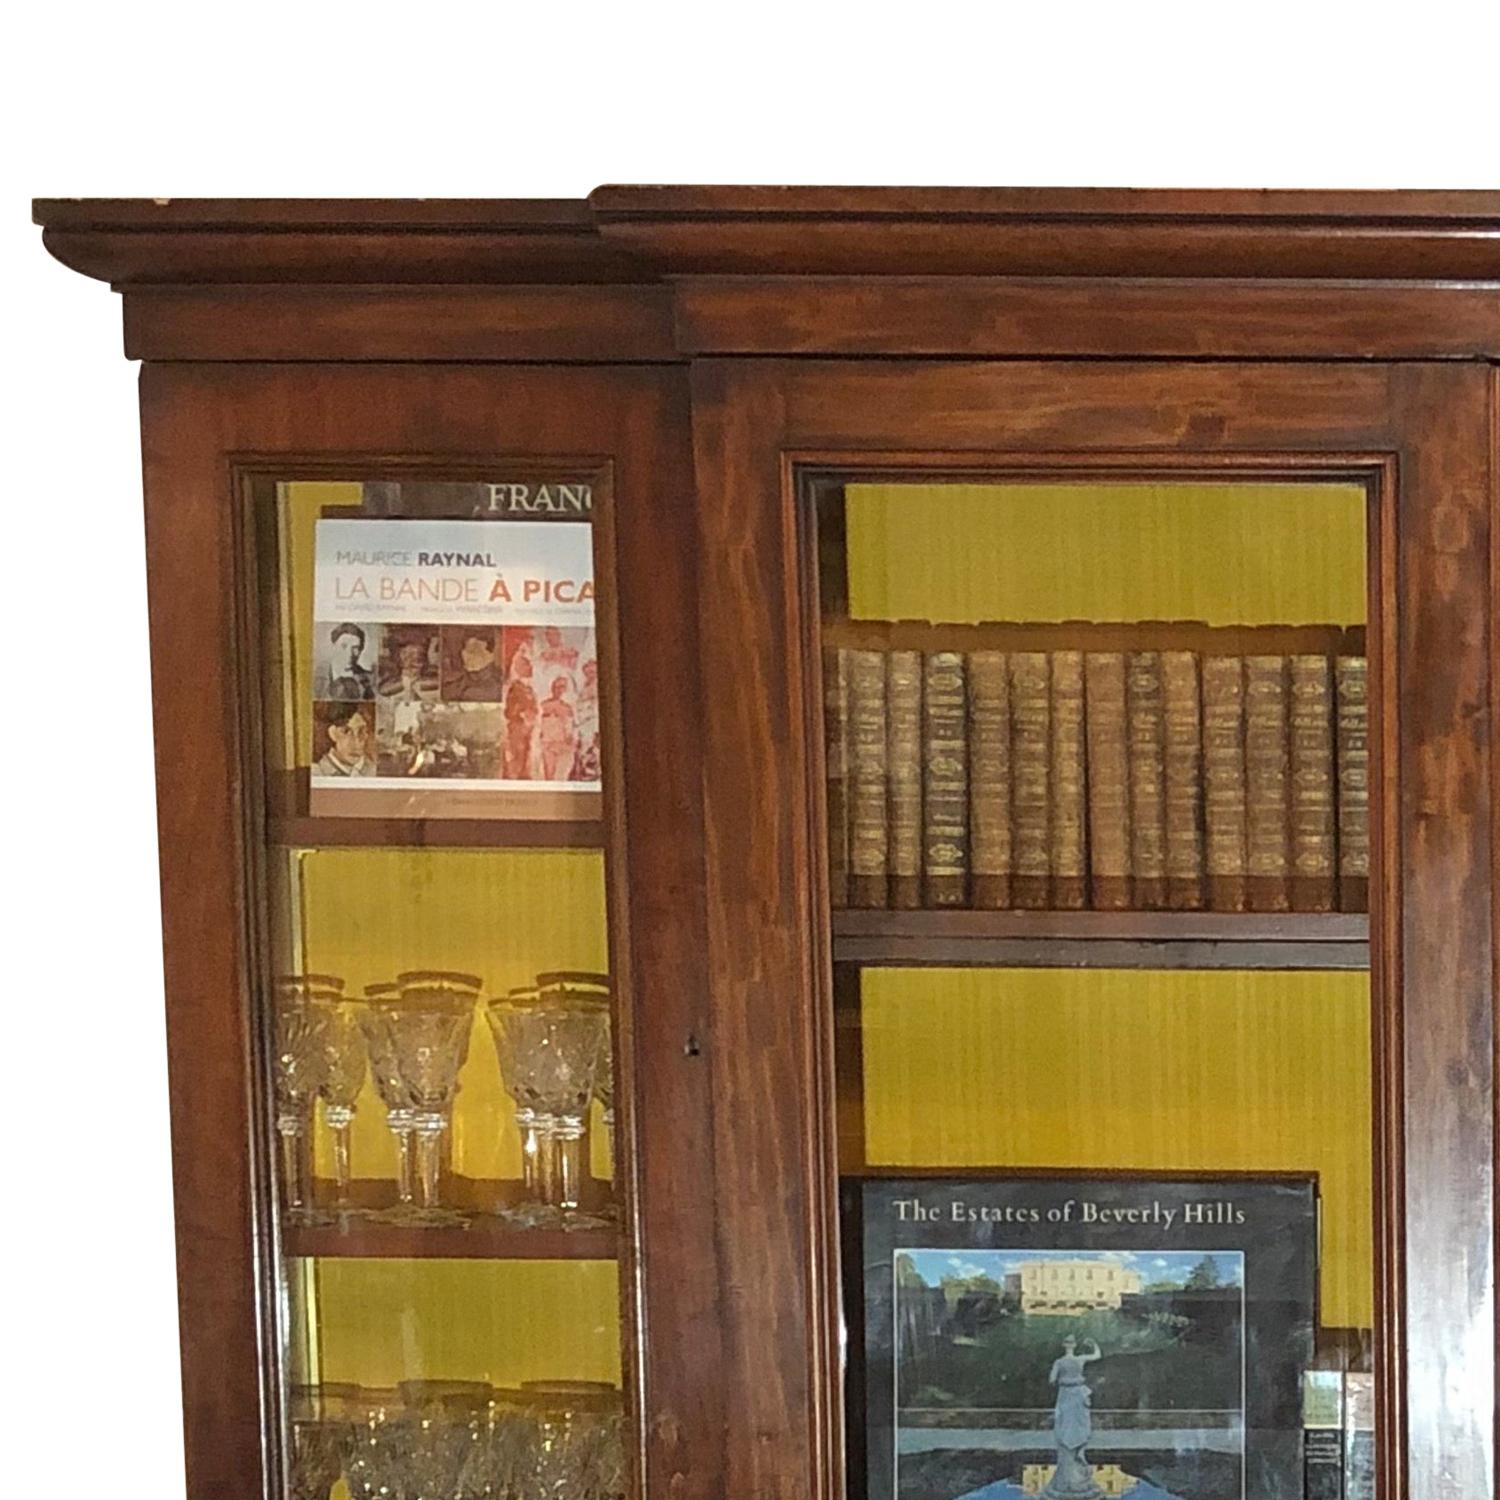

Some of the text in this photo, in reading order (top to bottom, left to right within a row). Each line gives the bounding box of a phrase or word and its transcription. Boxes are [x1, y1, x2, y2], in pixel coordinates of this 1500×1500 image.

[335, 550, 497, 567] MAURICE RAYNAL
[335, 577, 370, 600] LA
[380, 577, 479, 601] BANDE
[488, 572, 512, 602] À
[893, 1199, 1246, 1231] The Estates of Beverly Hills
